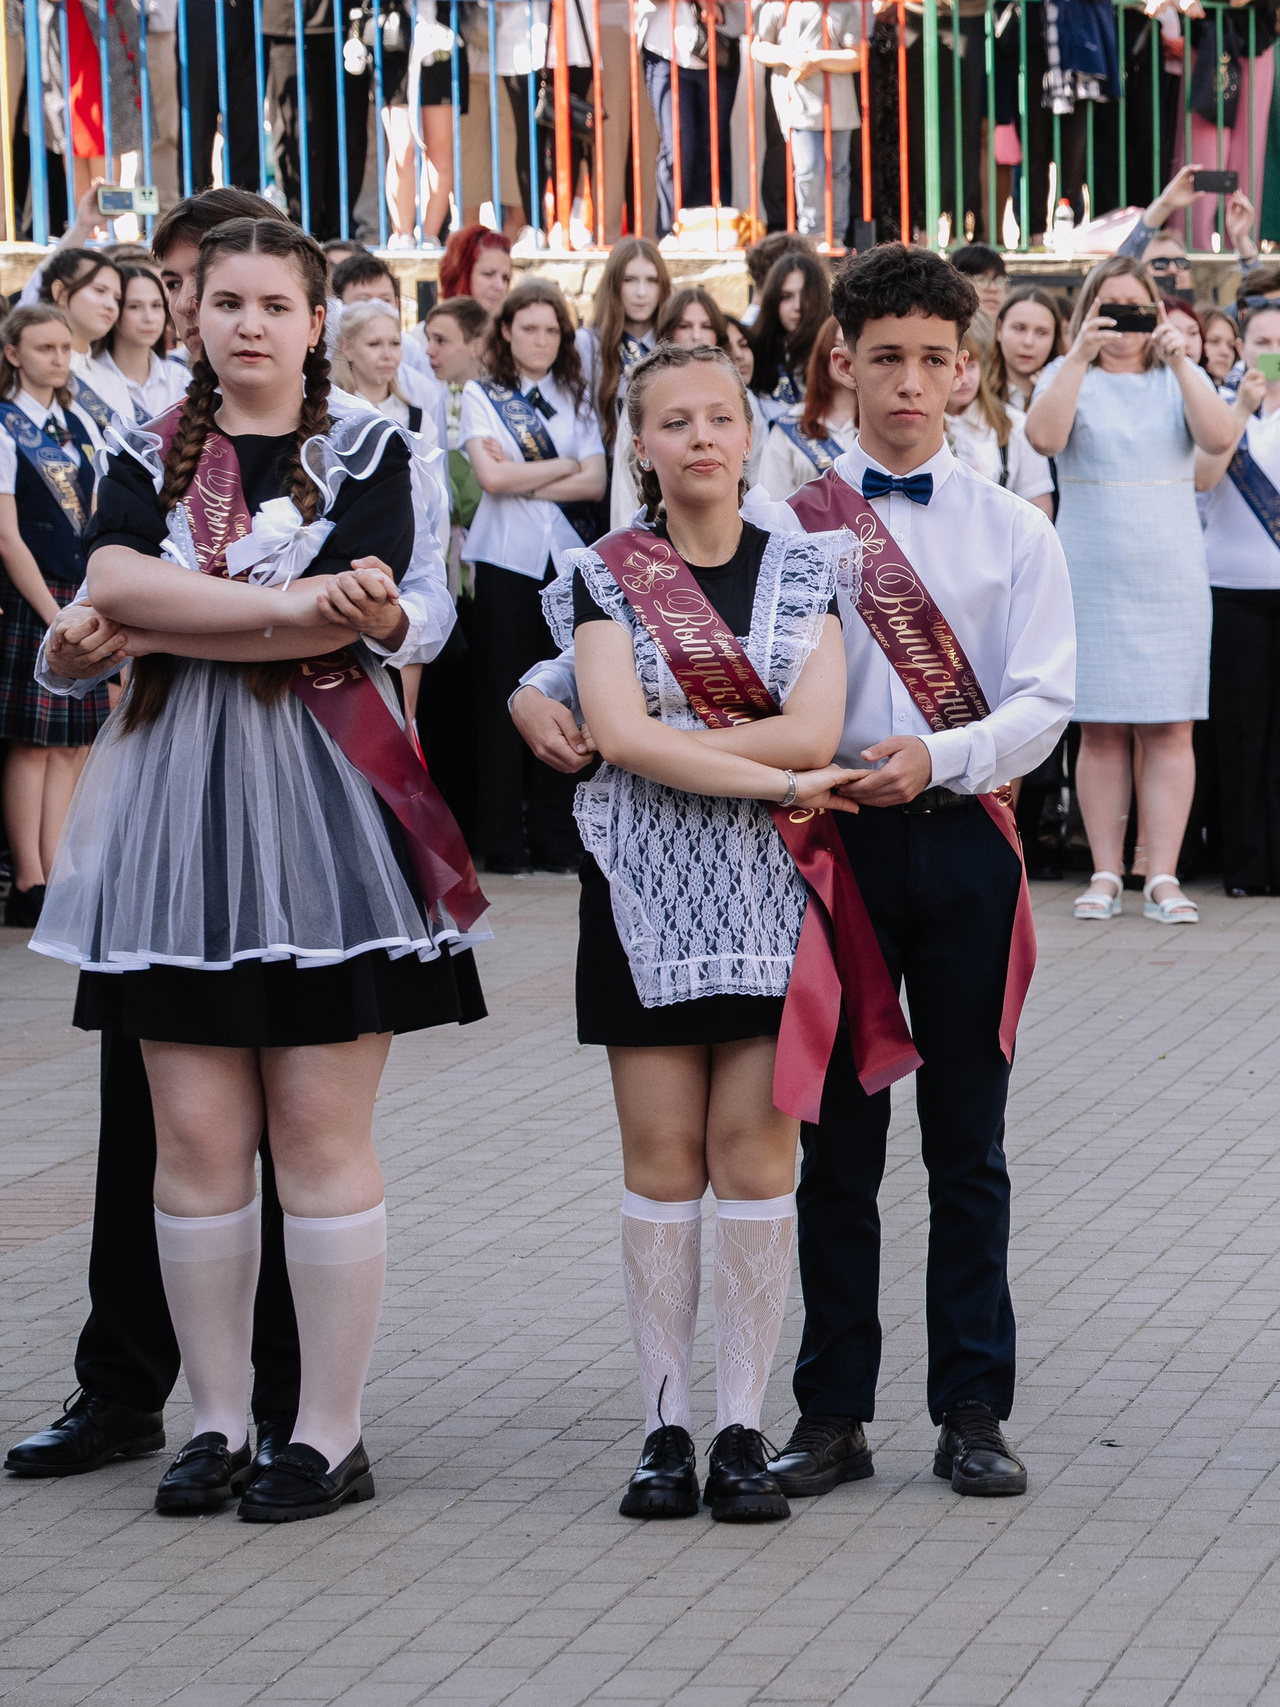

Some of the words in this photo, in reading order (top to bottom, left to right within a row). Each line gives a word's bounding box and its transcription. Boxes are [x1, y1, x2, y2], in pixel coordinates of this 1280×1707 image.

[870, 623, 890, 649] класс
[652, 637, 673, 662] класс
[710, 629, 750, 682] Ерофеева
